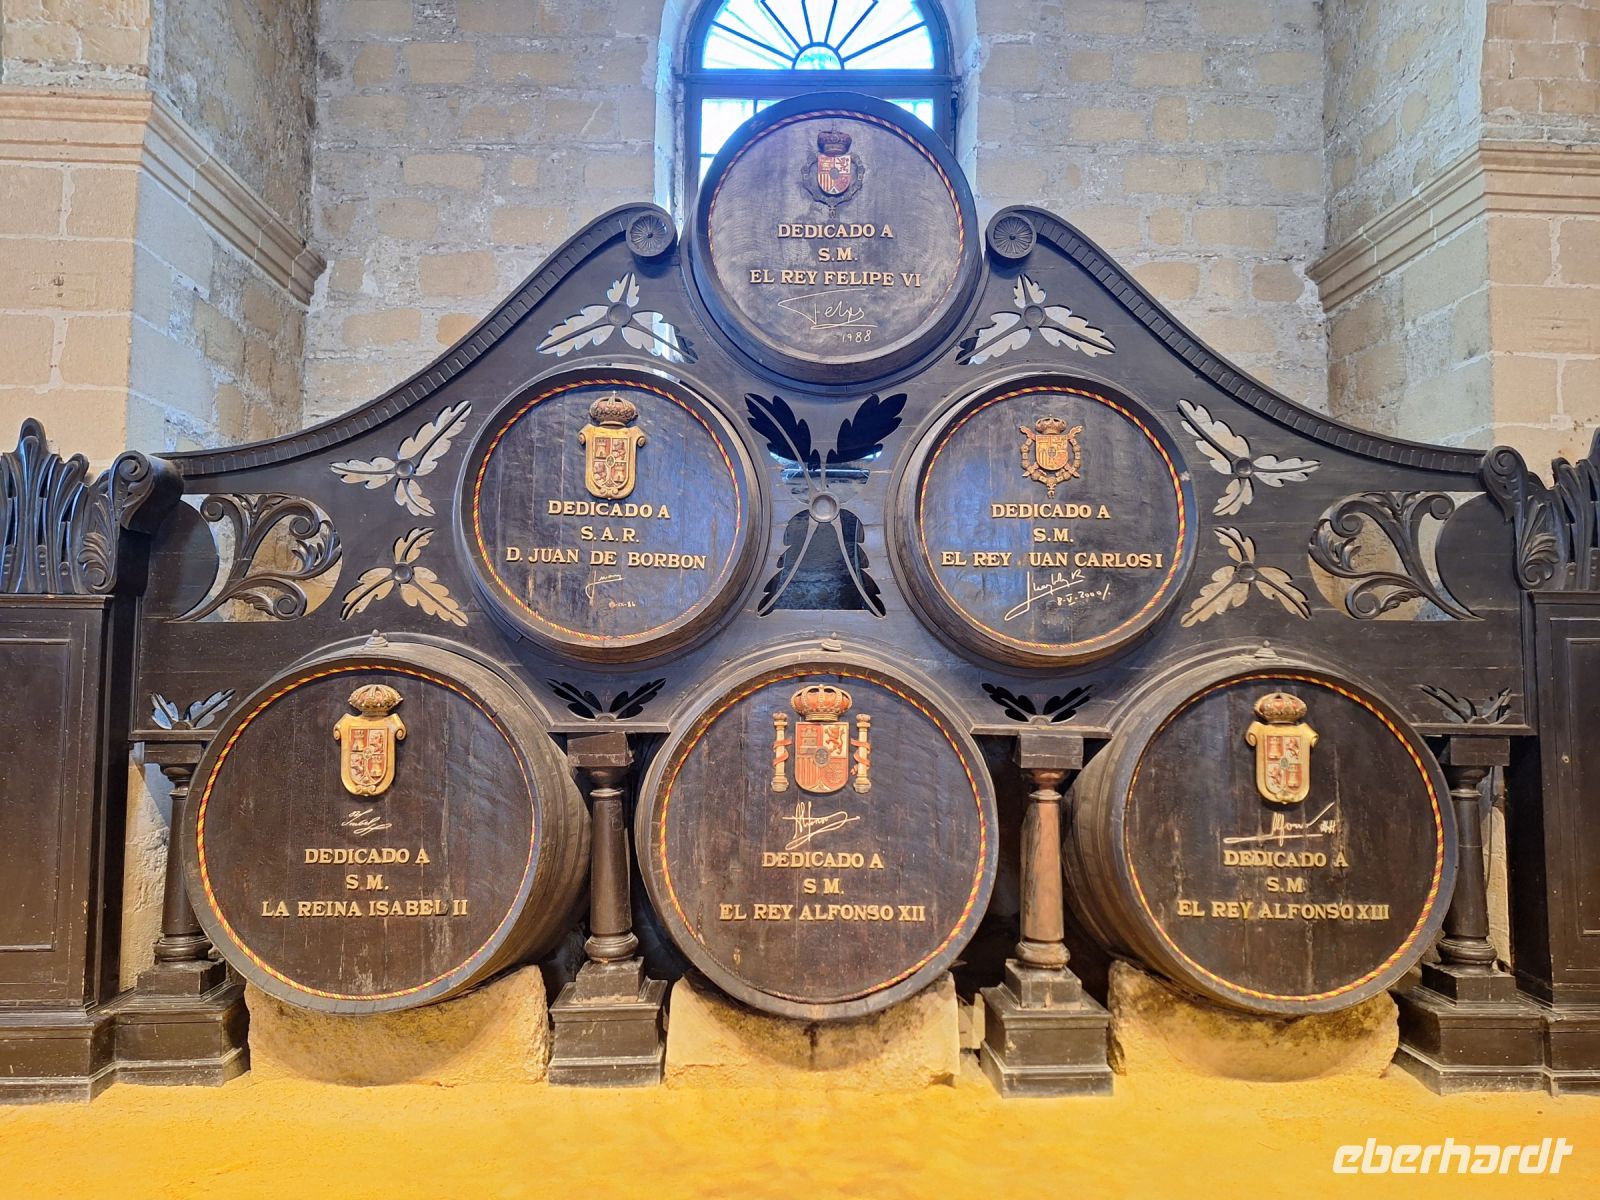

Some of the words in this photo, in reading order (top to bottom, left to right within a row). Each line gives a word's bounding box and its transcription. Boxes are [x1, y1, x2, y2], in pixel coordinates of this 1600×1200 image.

[777, 224, 875, 239] DEDICADO
[880, 225, 894, 239] A
[818, 247, 858, 262] S.M.
[750, 269, 775, 285] EL
[781, 270, 818, 286] REY
[823, 271, 895, 287] FELIPE
[901, 273, 921, 288] VI
[842, 329, 872, 343] 1988
[548, 500, 653, 518] DEDICADO
[656, 504, 671, 519] A
[991, 503, 1092, 519] DEDICADO
[1096, 504, 1111, 519] A
[580, 526, 640, 543] S.A.R.
[1033, 527, 1074, 543] S.M.
[506, 547, 523, 563] D.
[528, 548, 580, 564] JUAN
[590, 551, 617, 566] DE
[627, 552, 706, 569] BORBON
[941, 551, 967, 567] EL
[973, 552, 1012, 567] REY
[1074, 552, 1153, 569] CARLOS
[304, 848, 410, 865] DEDICADO
[415, 848, 430, 865] A
[762, 851, 865, 869] DEDICADO
[869, 853, 885, 869] A
[1223, 850, 1328, 868] DEDICADO
[1333, 852, 1349, 868] A
[261, 900, 290, 918] LA
[297, 901, 362, 918] REINA
[368, 900, 448, 917] ISABEL
[452, 899, 468, 916] II
[719, 902, 747, 921] EL
[753, 903, 793, 921] REY
[799, 903, 894, 922] ALFONSO
[898, 904, 925, 922] XII
[1177, 899, 1205, 917] EL
[1211, 901, 1251, 918] REY
[1257, 902, 1354, 920] ALFONSO
[1356, 904, 1389, 920] XIII
